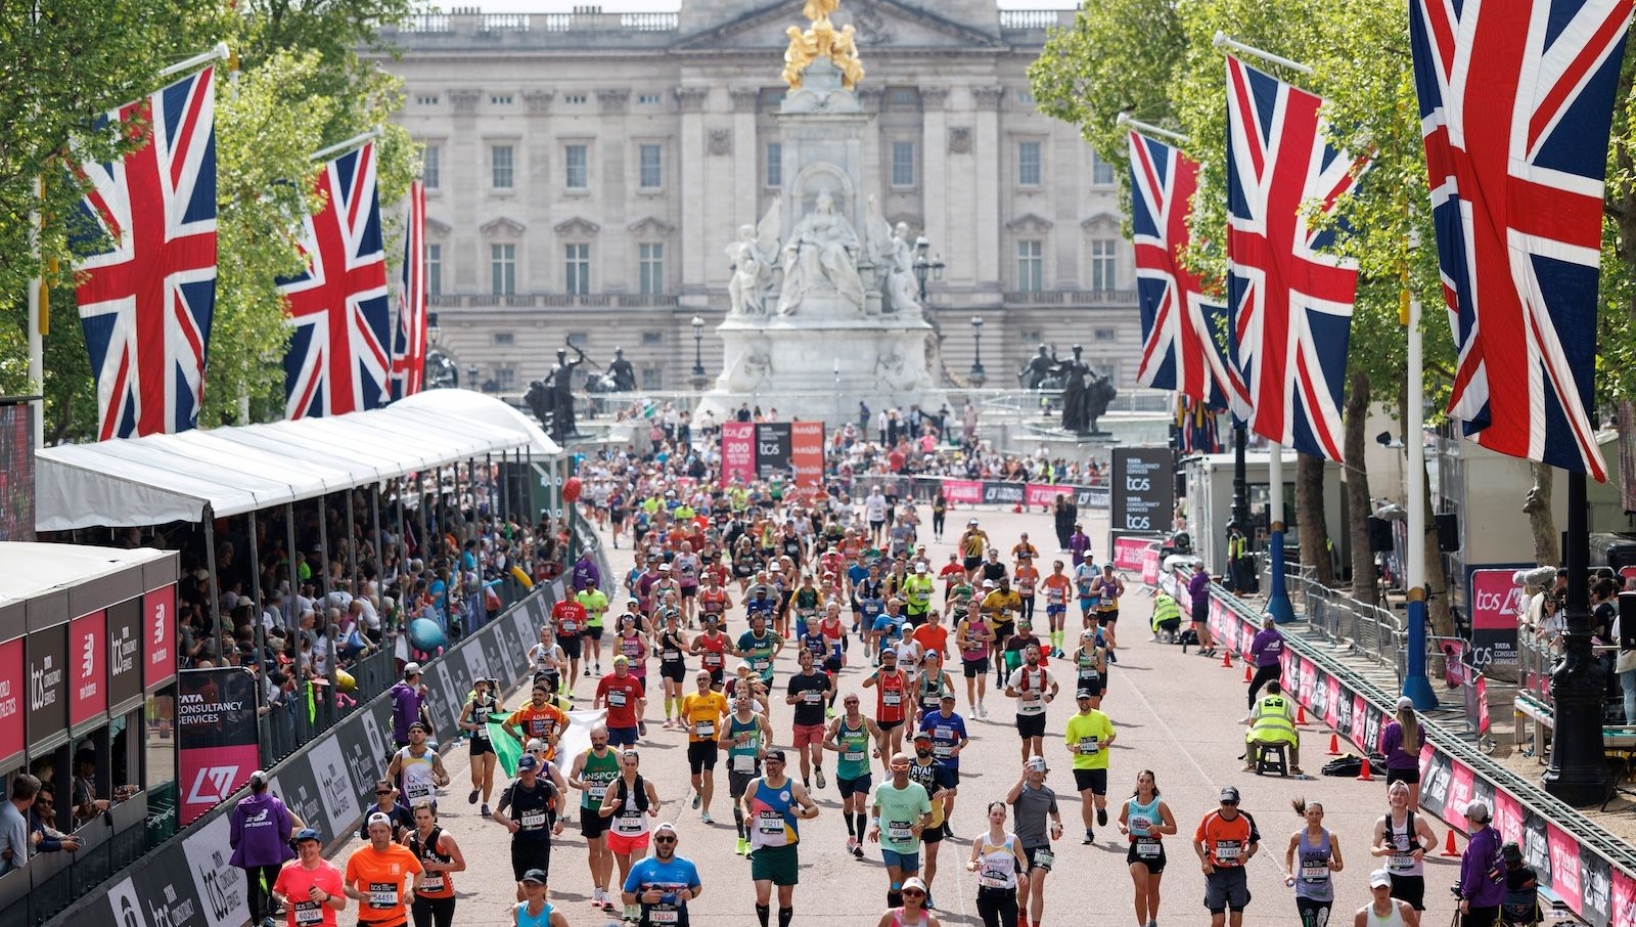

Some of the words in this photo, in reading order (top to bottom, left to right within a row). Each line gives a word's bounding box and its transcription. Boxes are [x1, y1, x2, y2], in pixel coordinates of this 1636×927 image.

[727, 442, 750, 453] 200
[760, 441, 780, 455] tcs
[1127, 475, 1150, 491] tcs
[1127, 513, 1150, 529] tcs
[1476, 589, 1501, 610] tcs
[31, 662, 44, 712] tcs
[585, 771, 617, 780] NSPCC
